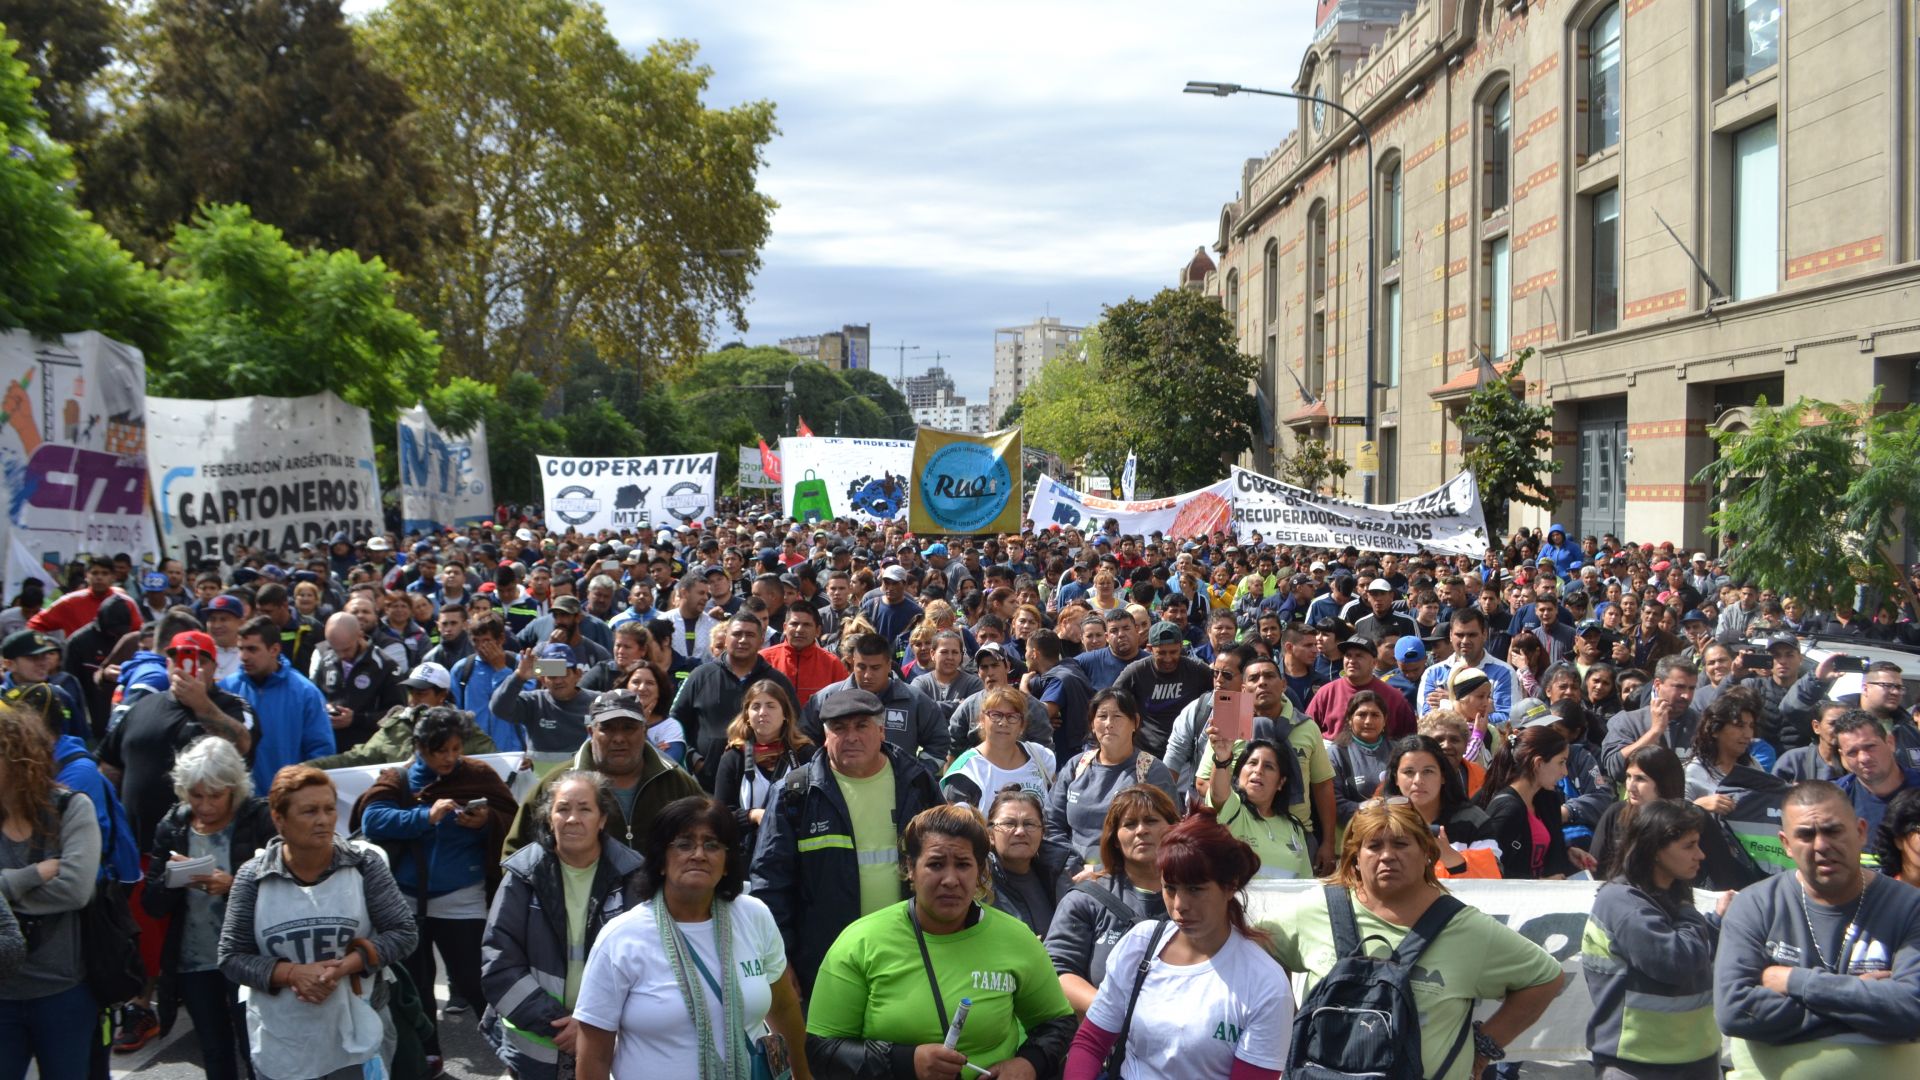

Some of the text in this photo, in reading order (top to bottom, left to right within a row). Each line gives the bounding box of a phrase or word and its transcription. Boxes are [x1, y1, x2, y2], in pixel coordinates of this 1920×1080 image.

[202, 454, 356, 477] FEDERACION ARGENTINA DE
[546, 456, 714, 477] COOPERATIVA
[179, 479, 371, 529] CARTONEROS Y
[1052, 501, 1081, 527] NO
[614, 511, 649, 524] MTE
[1235, 508, 1352, 528] RECUPERADORES
[1276, 530, 1405, 550] ESTEBAN ECHEVERRIA
[1151, 682, 1183, 700] NIKE
